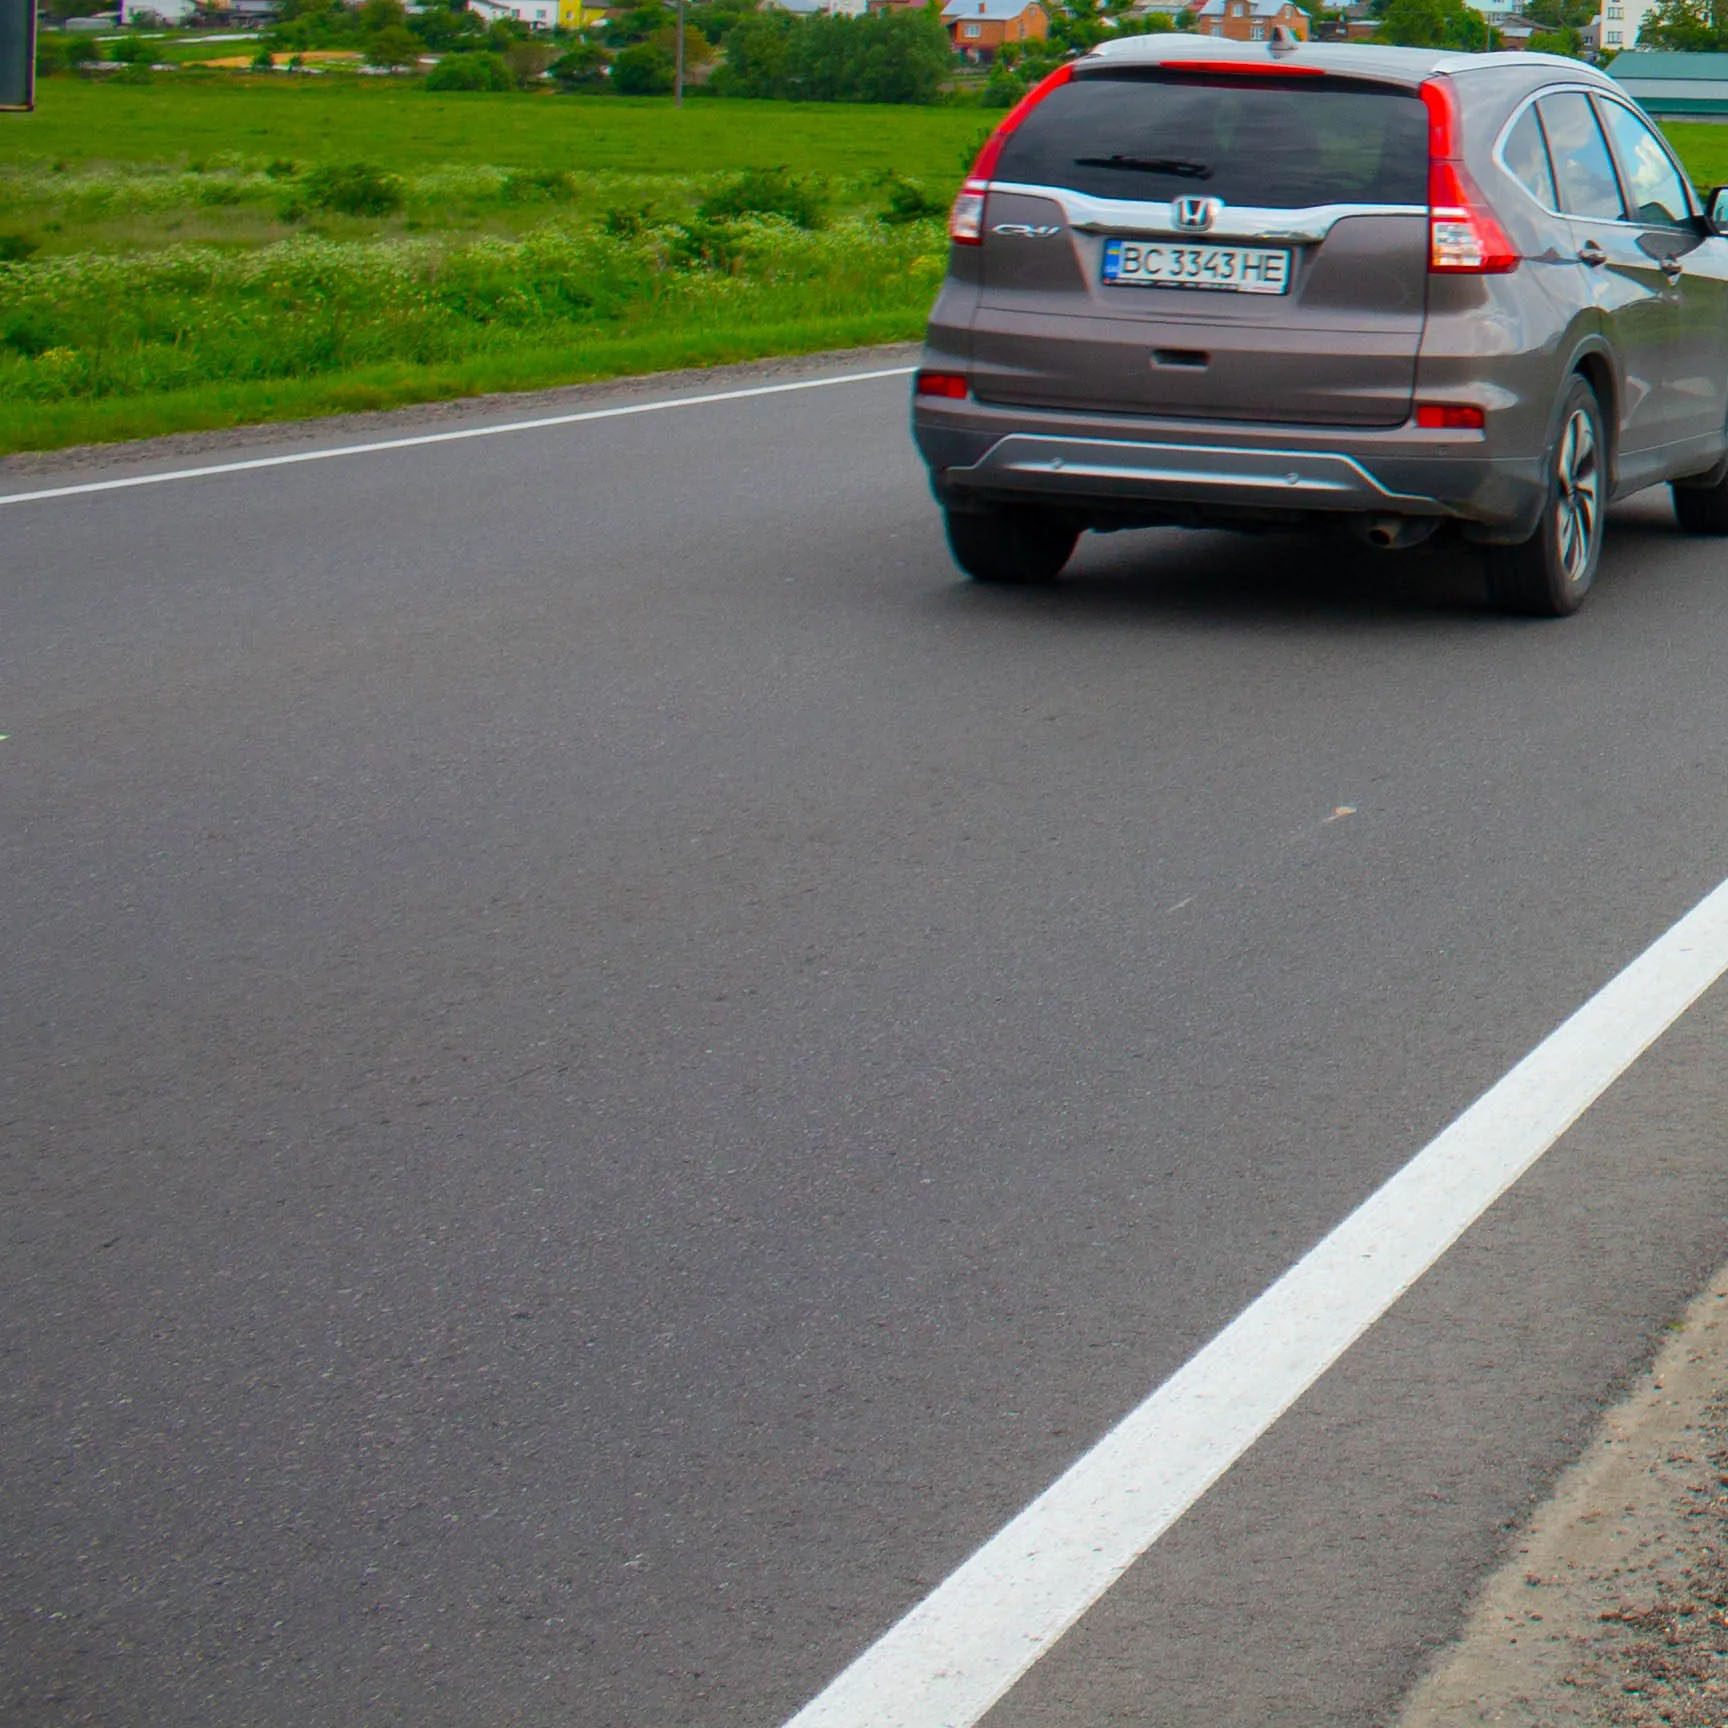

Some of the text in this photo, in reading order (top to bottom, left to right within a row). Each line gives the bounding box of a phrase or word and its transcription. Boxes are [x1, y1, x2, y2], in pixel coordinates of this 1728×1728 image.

[1122, 247, 1285, 282] BC 3343 HE
